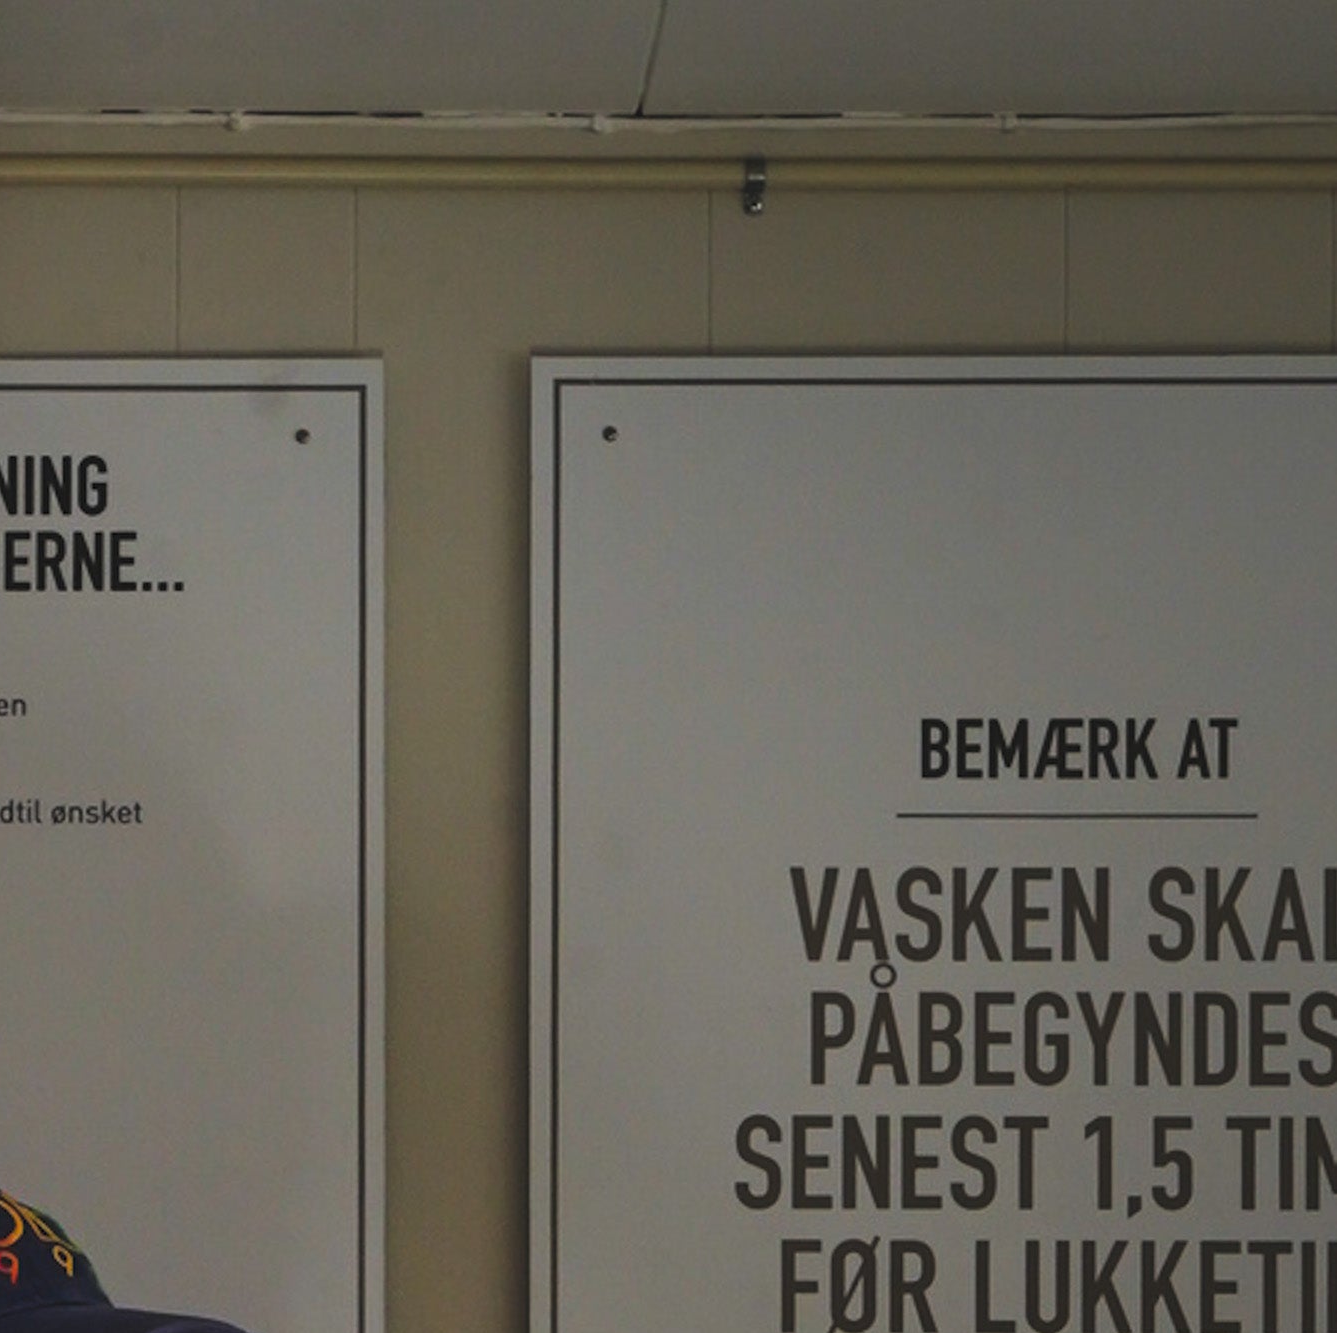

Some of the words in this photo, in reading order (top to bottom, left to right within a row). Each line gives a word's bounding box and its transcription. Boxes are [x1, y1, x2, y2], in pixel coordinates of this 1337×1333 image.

[920, 717, 1159, 780] BEMÆRK
[1176, 717, 1239, 780] AT
[50, 799, 143, 825] ønsket
[789, 865, 1111, 963] VASKEN
[808, 962, 1337, 1088] PÅBEGYNDES
[734, 1113, 1050, 1211] SENEST
[1084, 1115, 1194, 1219] 1,5
